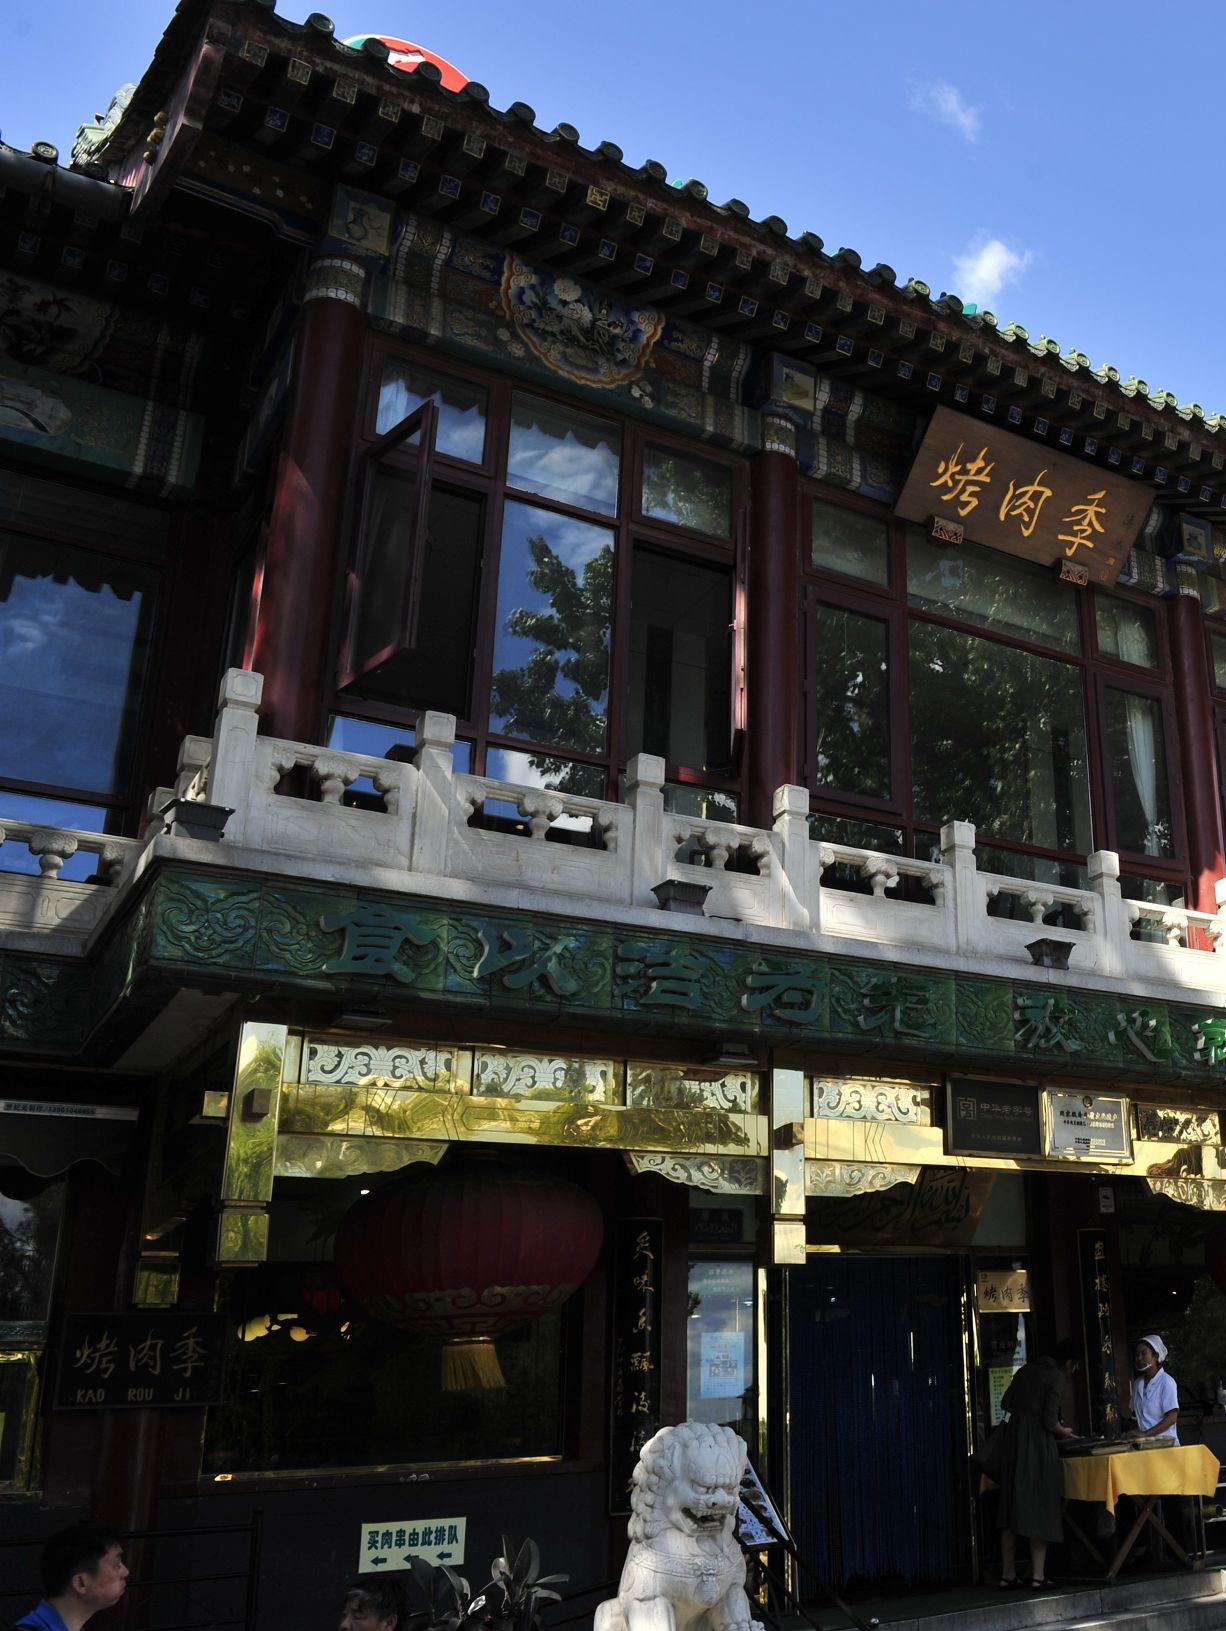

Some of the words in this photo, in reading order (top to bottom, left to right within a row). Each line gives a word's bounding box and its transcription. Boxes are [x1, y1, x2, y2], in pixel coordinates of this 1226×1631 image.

[930, 440, 1108, 557] 烤肉季
[983, 1283, 1030, 1304] 烤肉季
[73, 1325, 209, 1379] 烤肉季
[76, 1388, 105, 1403] KAO
[127, 1387, 154, 1402] ROU
[173, 1386, 191, 1401] JI
[367, 1524, 459, 1551] 买肉串由此排队
